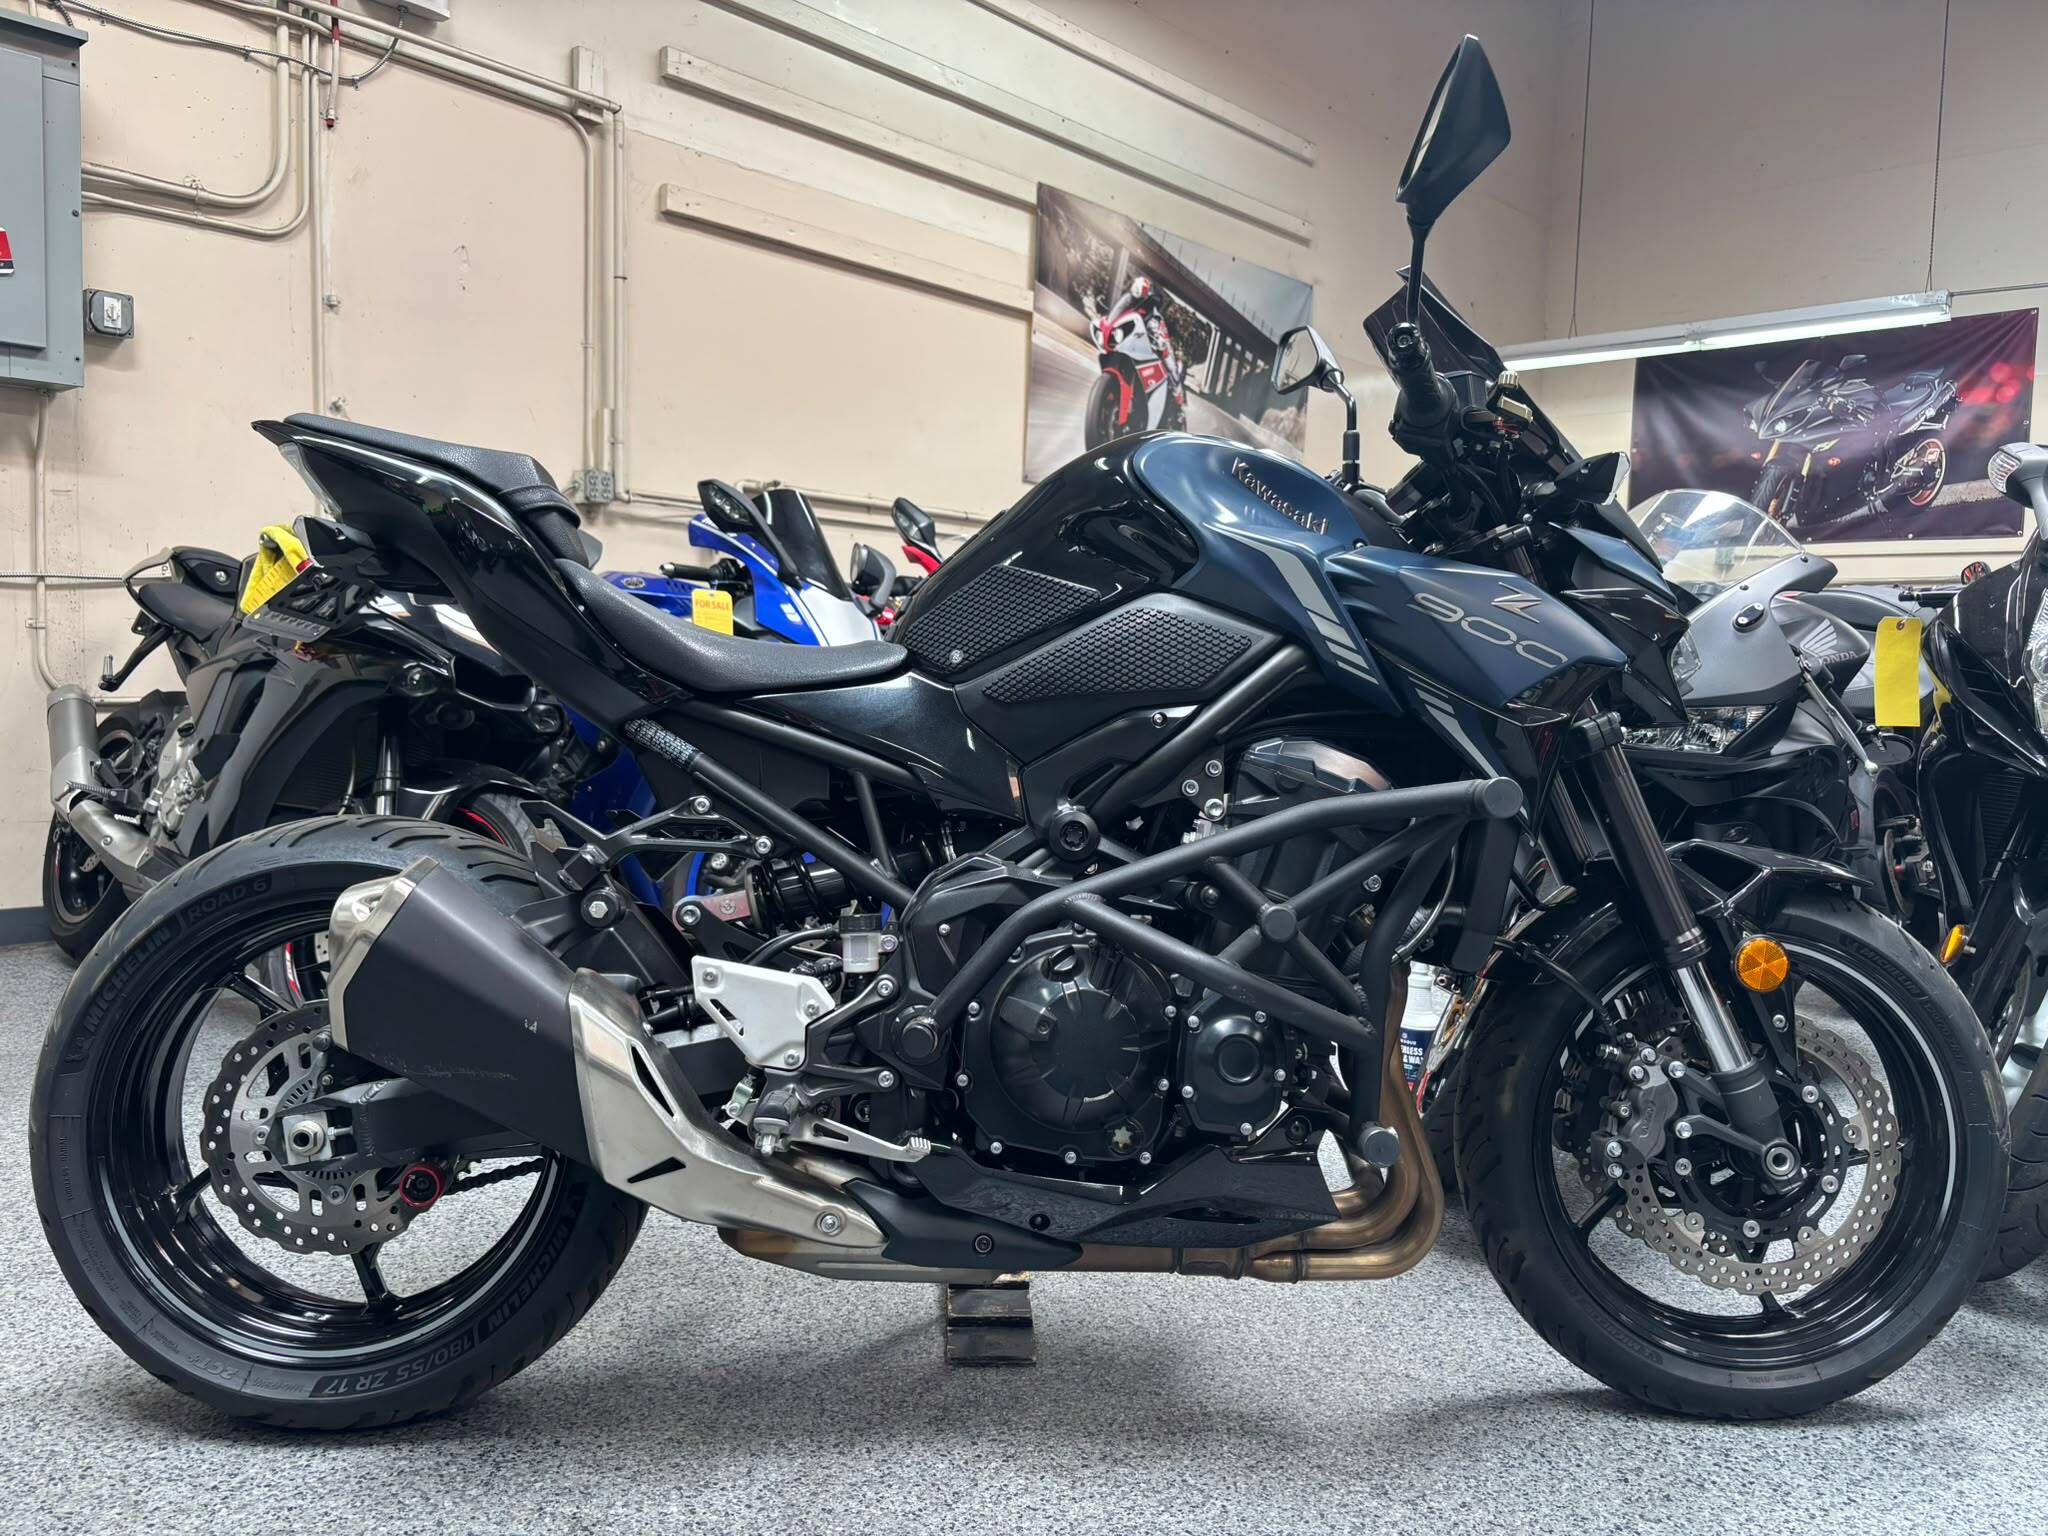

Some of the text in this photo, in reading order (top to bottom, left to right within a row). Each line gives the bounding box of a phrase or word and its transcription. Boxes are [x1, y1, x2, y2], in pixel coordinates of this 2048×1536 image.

[1231, 456, 1328, 536] Kawasaki
[695, 599, 730, 611] FOR SALE
[1405, 592, 1568, 669] 900
[86, 878, 267, 1034] MICHELIN ROAD 6
[487, 1224, 570, 1333] MICHELIN
[355, 1372, 388, 1391] ZR
[396, 1334, 472, 1378] 180/55
[325, 1379, 349, 1394] 17
